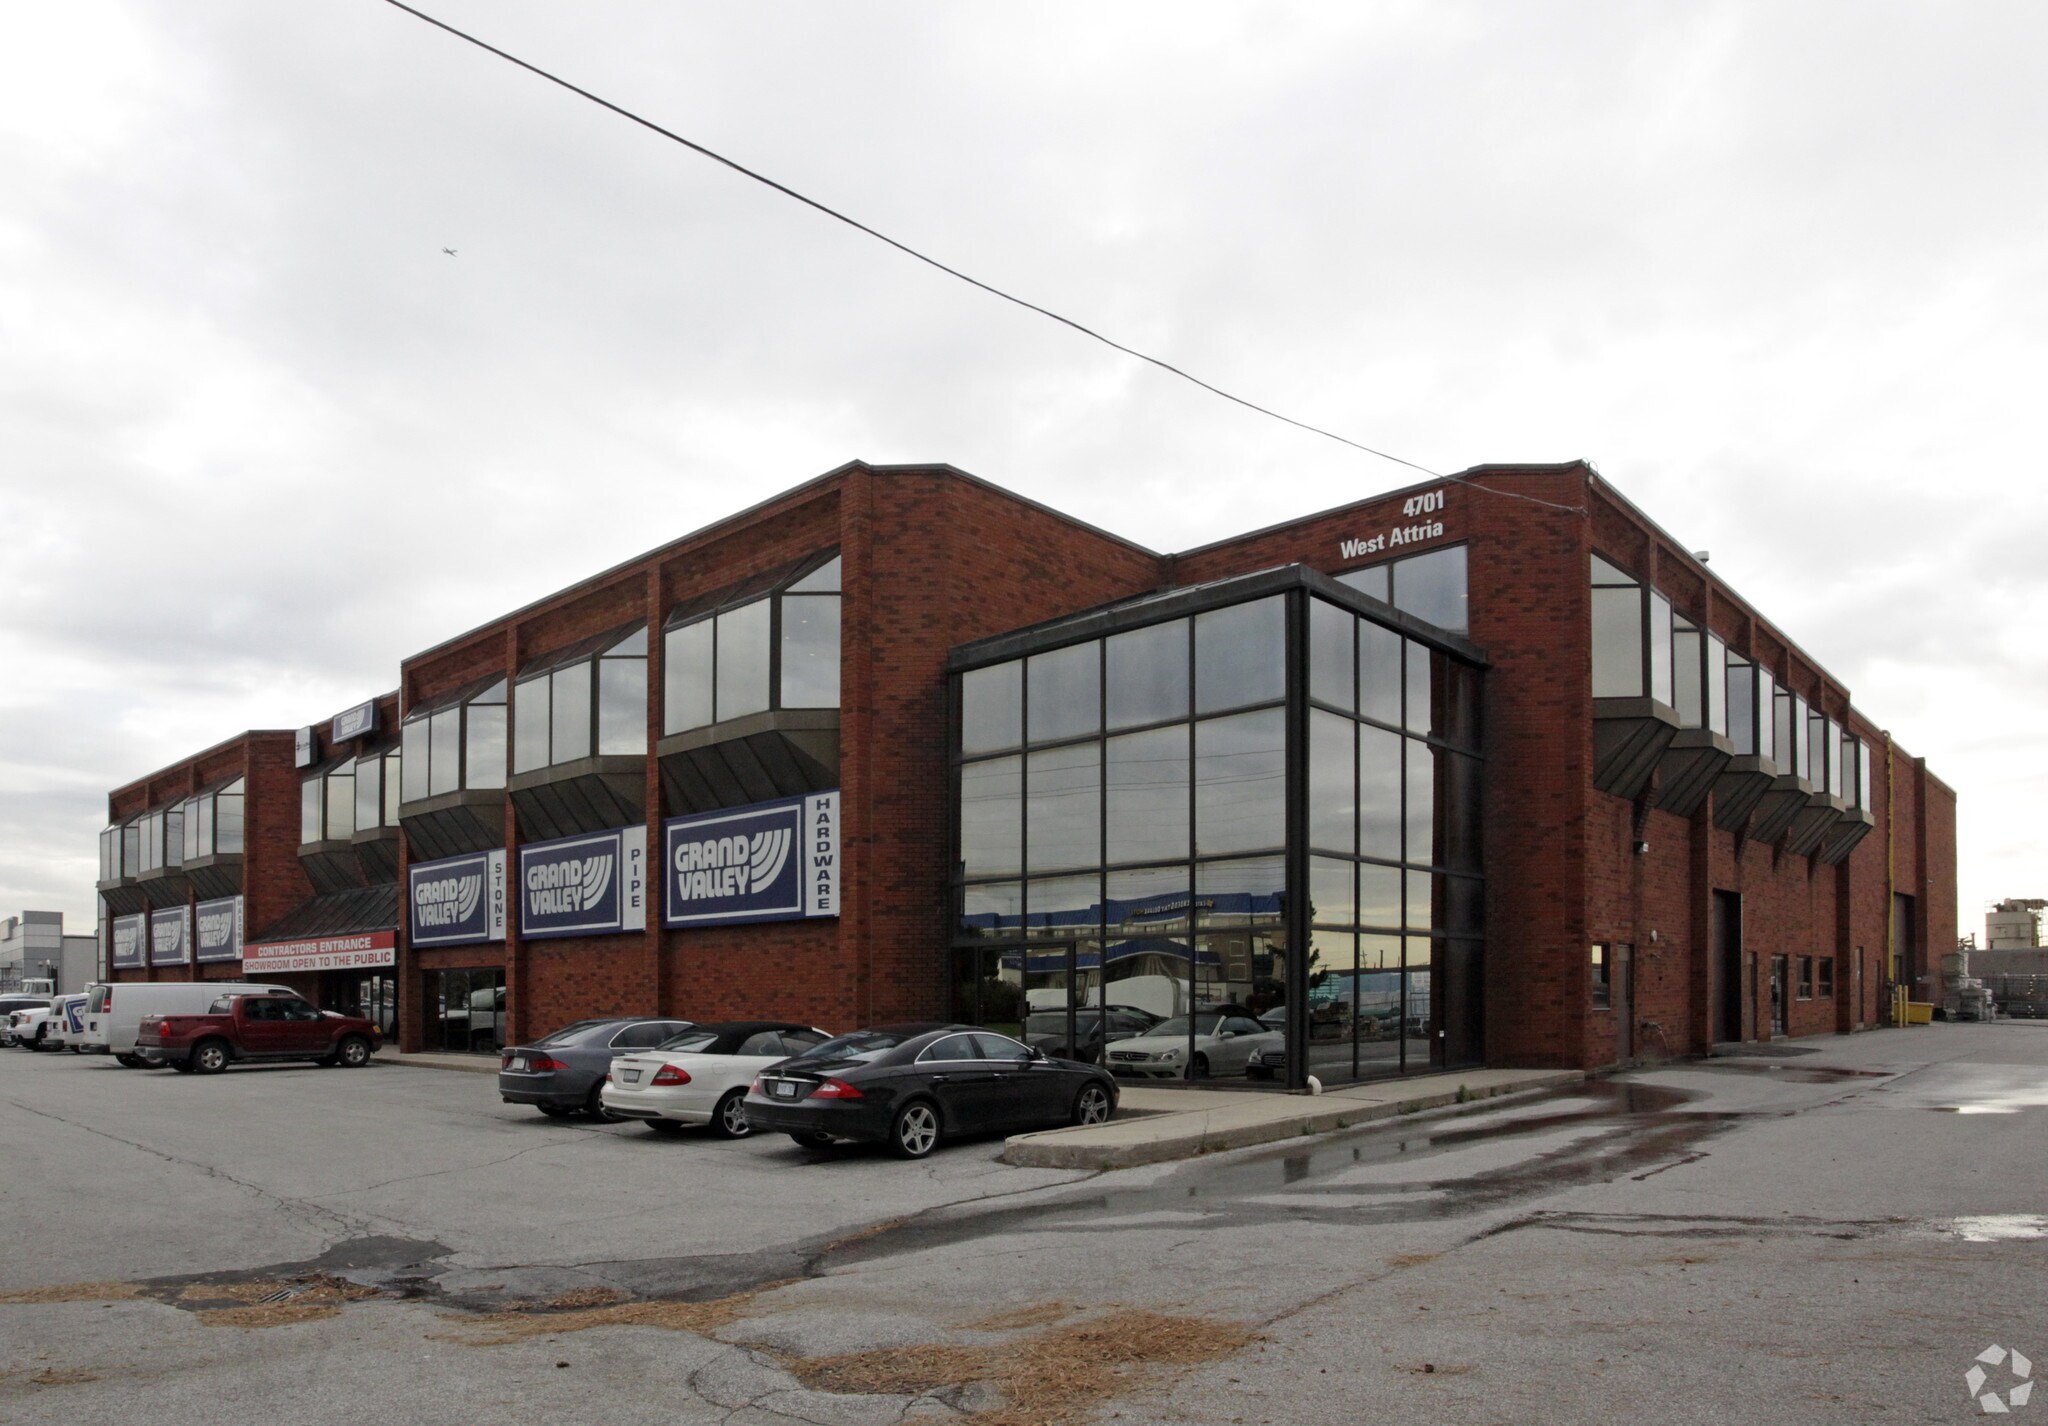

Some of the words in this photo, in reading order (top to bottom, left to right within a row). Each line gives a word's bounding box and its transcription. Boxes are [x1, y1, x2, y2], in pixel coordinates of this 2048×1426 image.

[1403, 490, 1444, 517] 4701
[1340, 532, 1385, 560] West
[1389, 519, 1443, 547] Attria
[674, 836, 750, 871] GRAND
[813, 797, 834, 910] HARDWARE
[527, 857, 584, 891] GRAND
[630, 848, 640, 908] PIPE
[678, 865, 750, 900] VALLEY
[415, 877, 459, 905] GRAND
[494, 862, 503, 928] STONE
[530, 886, 585, 915] VALLEY
[199, 914, 221, 933] GRAND
[418, 901, 460, 927] VALLEY
[200, 930, 221, 948] VALLEY
[258, 943, 317, 957] CONTRACTORS
[320, 937, 372, 952] ENTRANCE
[244, 959, 290, 971] SHOWROOM
[292, 957, 316, 968] OPEN
[319, 956, 330, 967] TO
[333, 954, 351, 966] THE
[354, 952, 391, 964] PUBLIC
